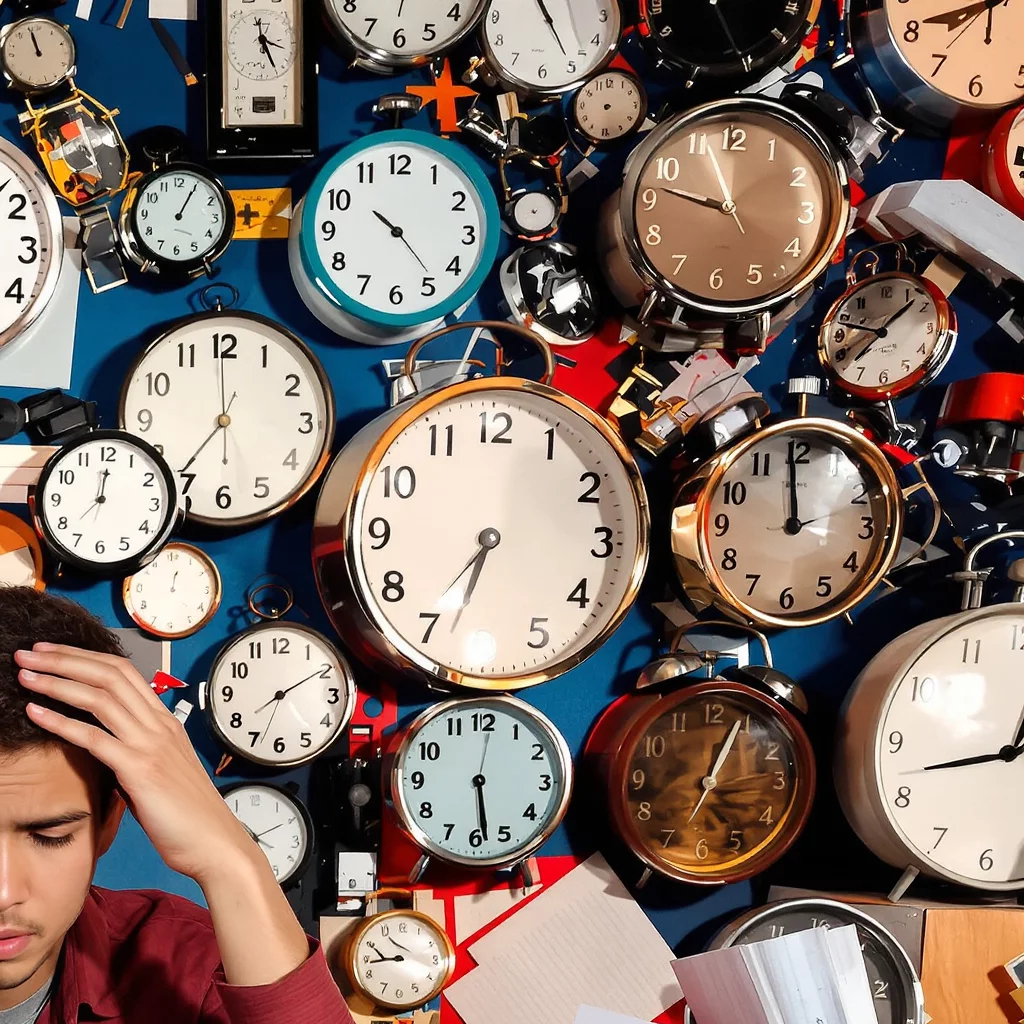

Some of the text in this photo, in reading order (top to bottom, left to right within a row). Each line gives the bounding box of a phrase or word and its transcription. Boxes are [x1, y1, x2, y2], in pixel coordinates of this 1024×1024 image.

[393, 29, 406, 48] 6
[904, 20, 919, 42] 8
[931, 54, 947, 77] 7
[358, 162, 373, 183] 11
[389, 154, 411, 175] 12
[431, 165, 437, 184] 1
[174, 178, 184, 187] 12
[8, 194, 26, 220] 2
[328, 189, 350, 211] 10
[452, 191, 465, 211] 2
[322, 221, 335, 241] 9
[462, 226, 475, 245] 3
[646, 225, 661, 245] 8
[18, 236, 37, 264] 3
[332, 252, 345, 271] 8
[446, 256, 461, 276] 4
[710, 269, 723, 289] 6
[747, 264, 762, 284] 5
[5, 278, 24, 303] 4
[357, 275, 371, 295] 7
[389, 285, 403, 305] 6
[421, 277, 435, 296] 5
[285, 374, 300, 396] 2
[298, 412, 313, 434] 3
[481, 413, 512, 443] 12
[429, 425, 453, 456] 11
[545, 428, 554, 460] 1
[101, 447, 116, 462] 12
[786, 440, 810, 464] 12
[59, 470, 74, 485] 10
[143, 473, 154, 487] 2
[381, 466, 416, 499] 10
[578, 471, 601, 504] 2
[51, 493, 61, 507] 9
[216, 486, 231, 509] 6
[723, 481, 746, 505] 10
[369, 517, 390, 550] 9
[715, 514, 729, 537] 9
[591, 527, 613, 558] 3
[382, 571, 404, 602] 8
[567, 578, 589, 608] 4
[780, 587, 794, 609] 6
[419, 613, 440, 643] 7
[527, 618, 549, 649] 5
[231, 662, 248, 679] 10
[328, 688, 339, 704] 3
[230, 713, 242, 728] 8
[448, 718, 461, 735] 11
[513, 724, 518, 740] 1
[419, 742, 440, 760] 10
[531, 744, 544, 761] 2
[411, 771, 424, 789] 9
[539, 775, 551, 791] 3
[420, 802, 432, 818] 8
[523, 803, 537, 821] 4
[444, 824, 455, 840] 7
[469, 829, 482, 847] 6
[498, 826, 511, 842] 5
